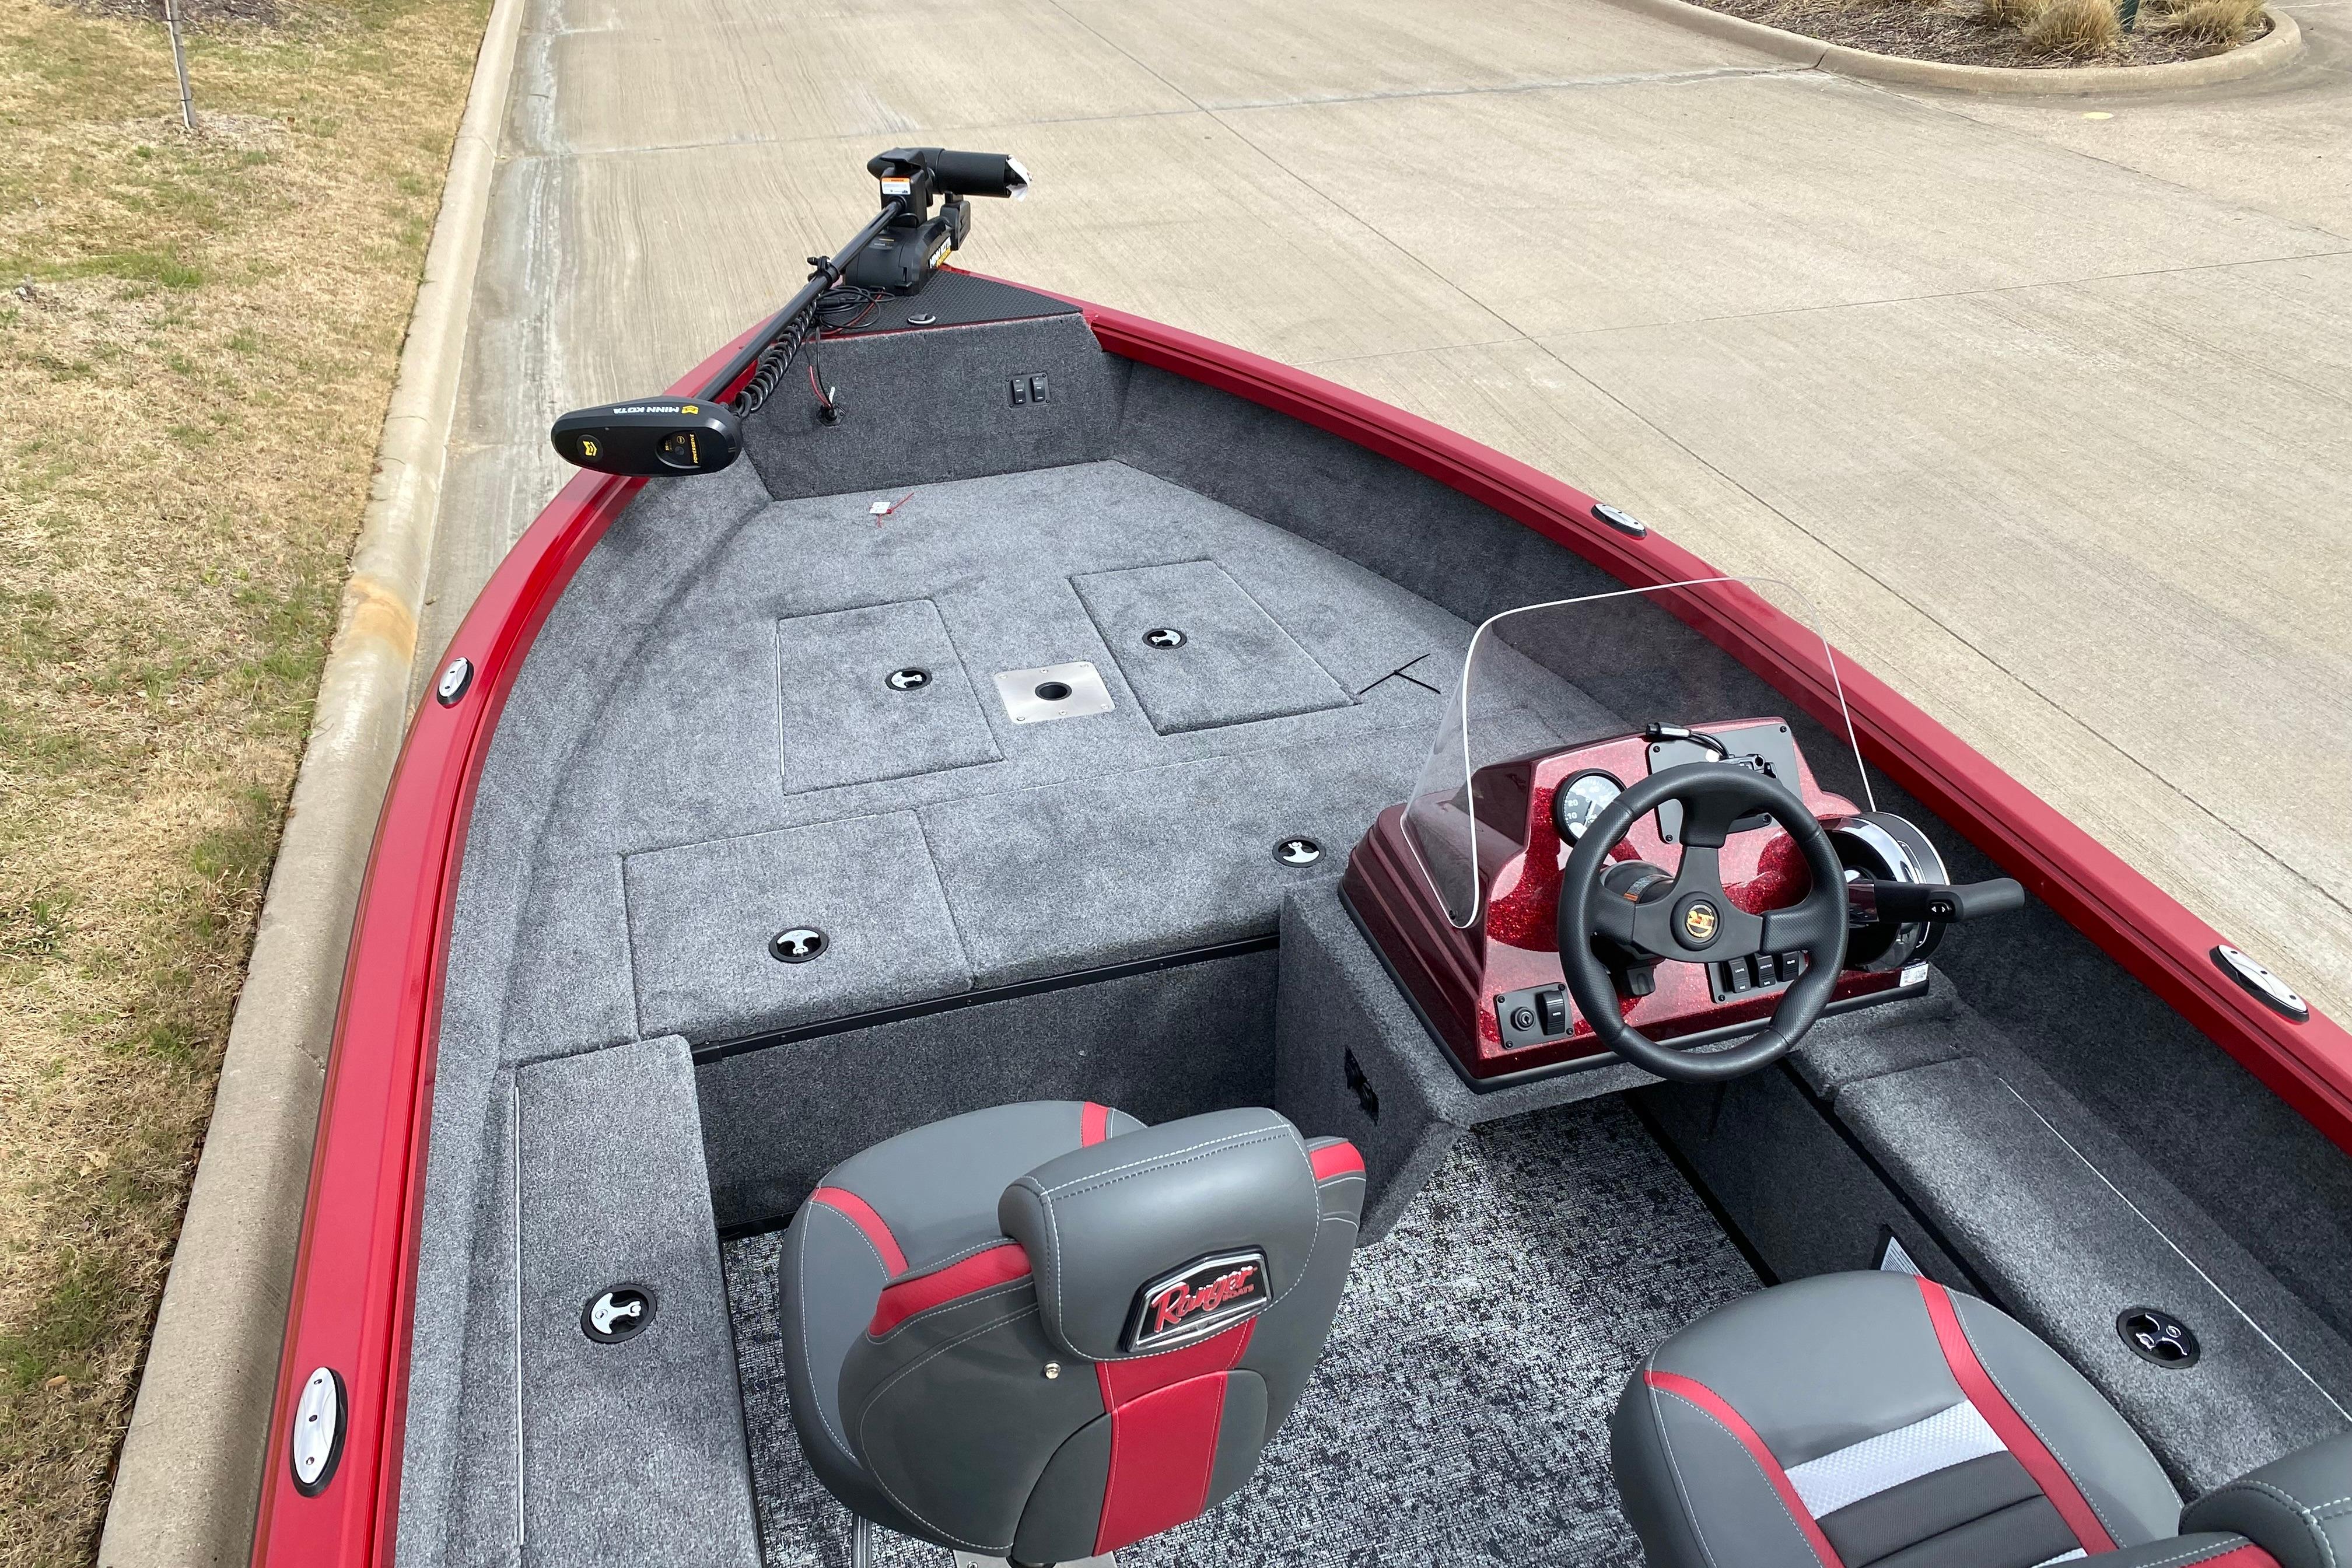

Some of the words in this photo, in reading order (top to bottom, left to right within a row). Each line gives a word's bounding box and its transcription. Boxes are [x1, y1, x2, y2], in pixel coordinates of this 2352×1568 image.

[690, 433, 698, 464] POWERDRIVE
[1567, 799, 1578, 807] 20
[1567, 811, 1577, 820] 10
[1150, 1265, 1254, 1334] Ranger
